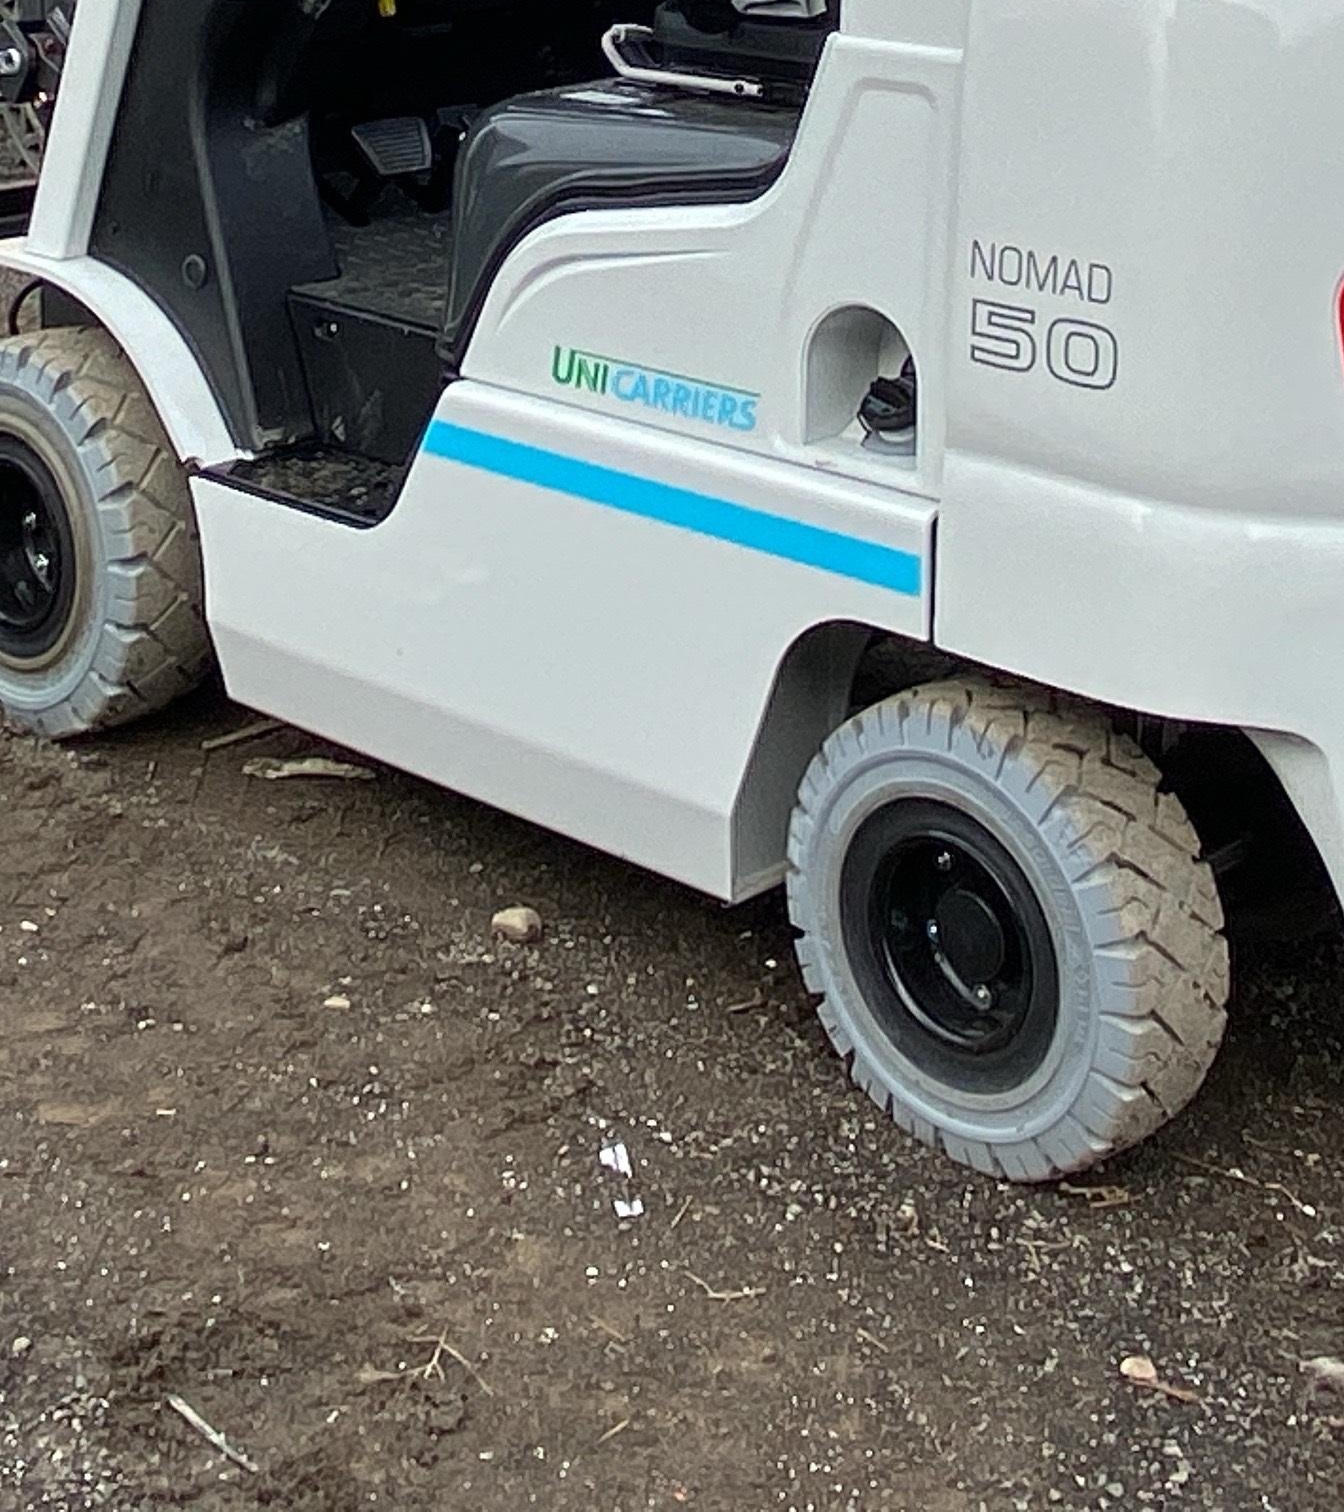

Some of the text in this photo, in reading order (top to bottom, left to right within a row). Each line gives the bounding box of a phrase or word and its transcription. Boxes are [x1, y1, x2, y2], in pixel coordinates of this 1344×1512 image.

[970, 239, 1112, 304] NOMAD
[970, 298, 1118, 390] 50
[552, 345, 760, 431] UNICARRIERS
